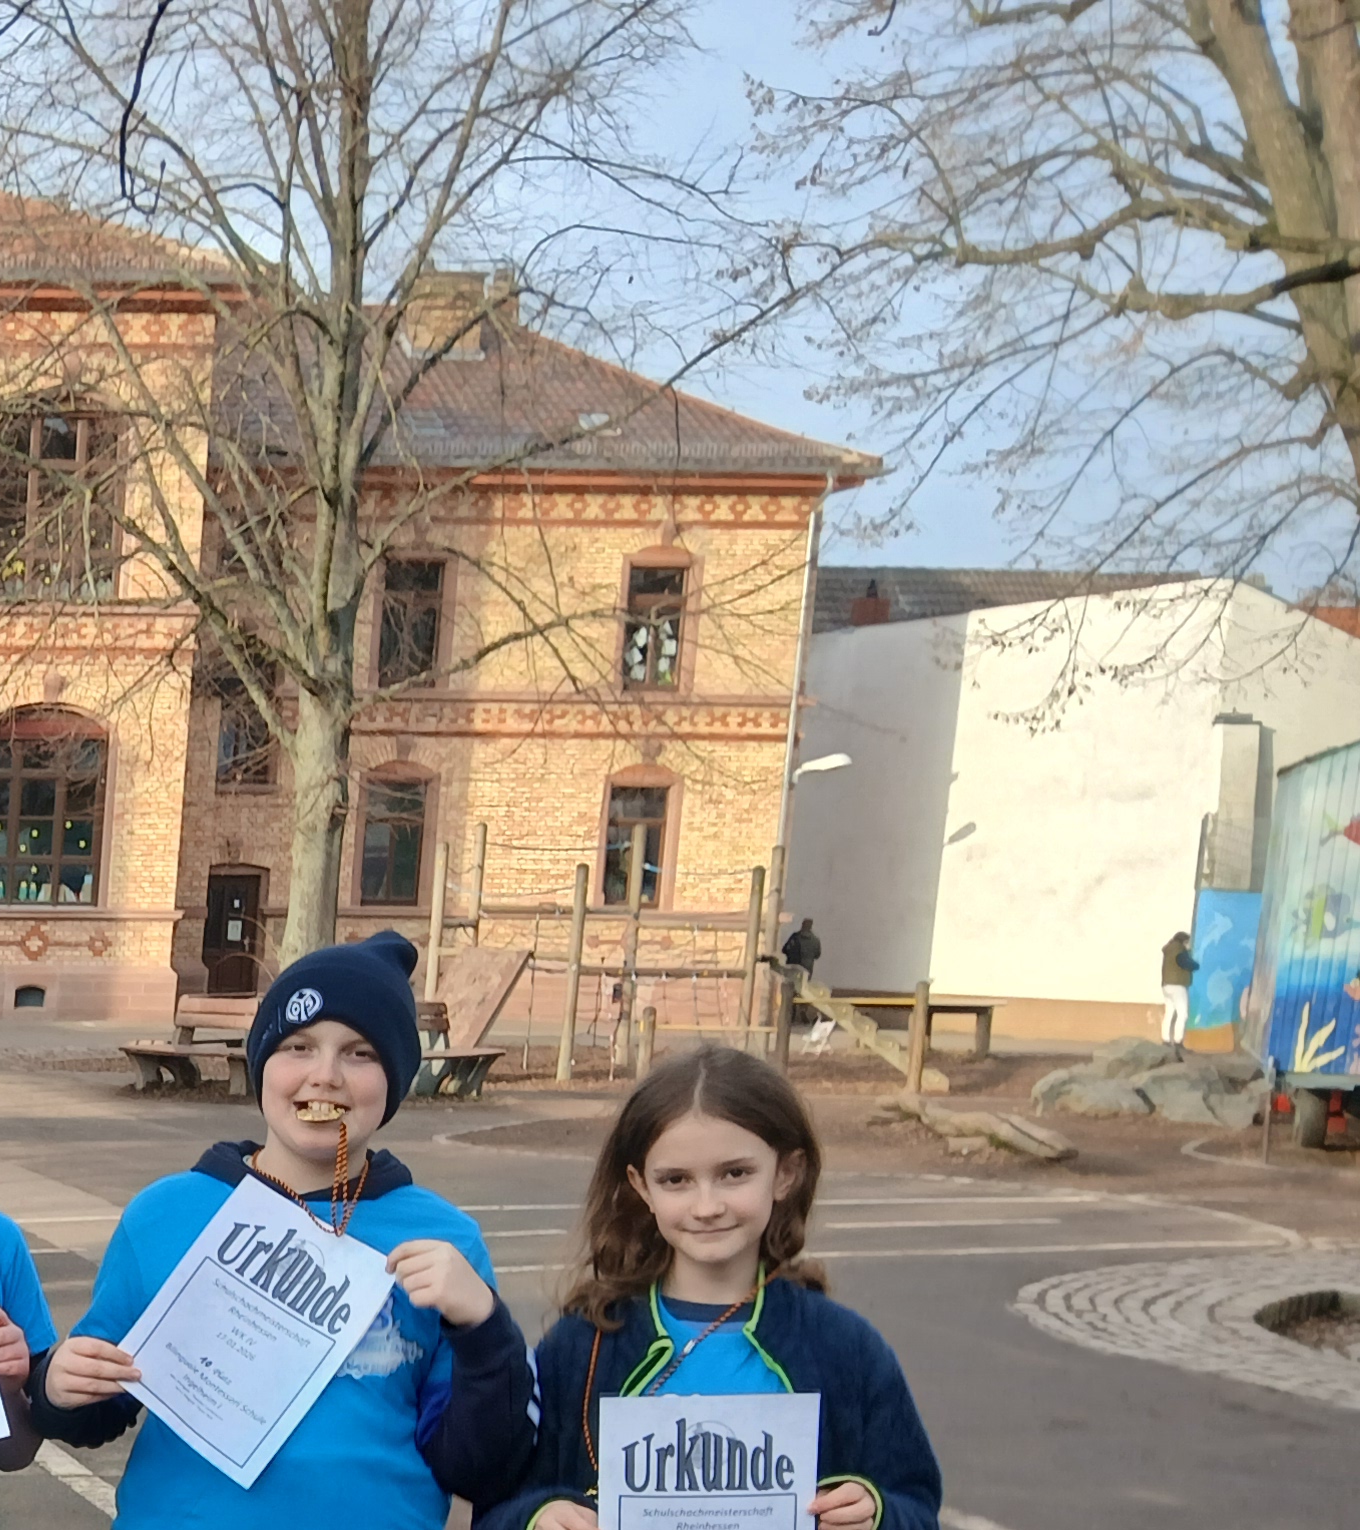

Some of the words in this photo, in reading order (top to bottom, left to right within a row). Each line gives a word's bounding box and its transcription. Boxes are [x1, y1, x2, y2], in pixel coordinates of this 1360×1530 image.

[217, 1222, 351, 1335] Urkunde
[231, 1326, 247, 1339] WK
[182, 1373, 218, 1409] Ingelheim
[239, 1404, 267, 1425] Schule
[621, 1418, 795, 1492] Urkunde
[642, 1506, 773, 1518] Schulschachmeisterschaft
[676, 1522, 740, 1530] Rheinhessen
